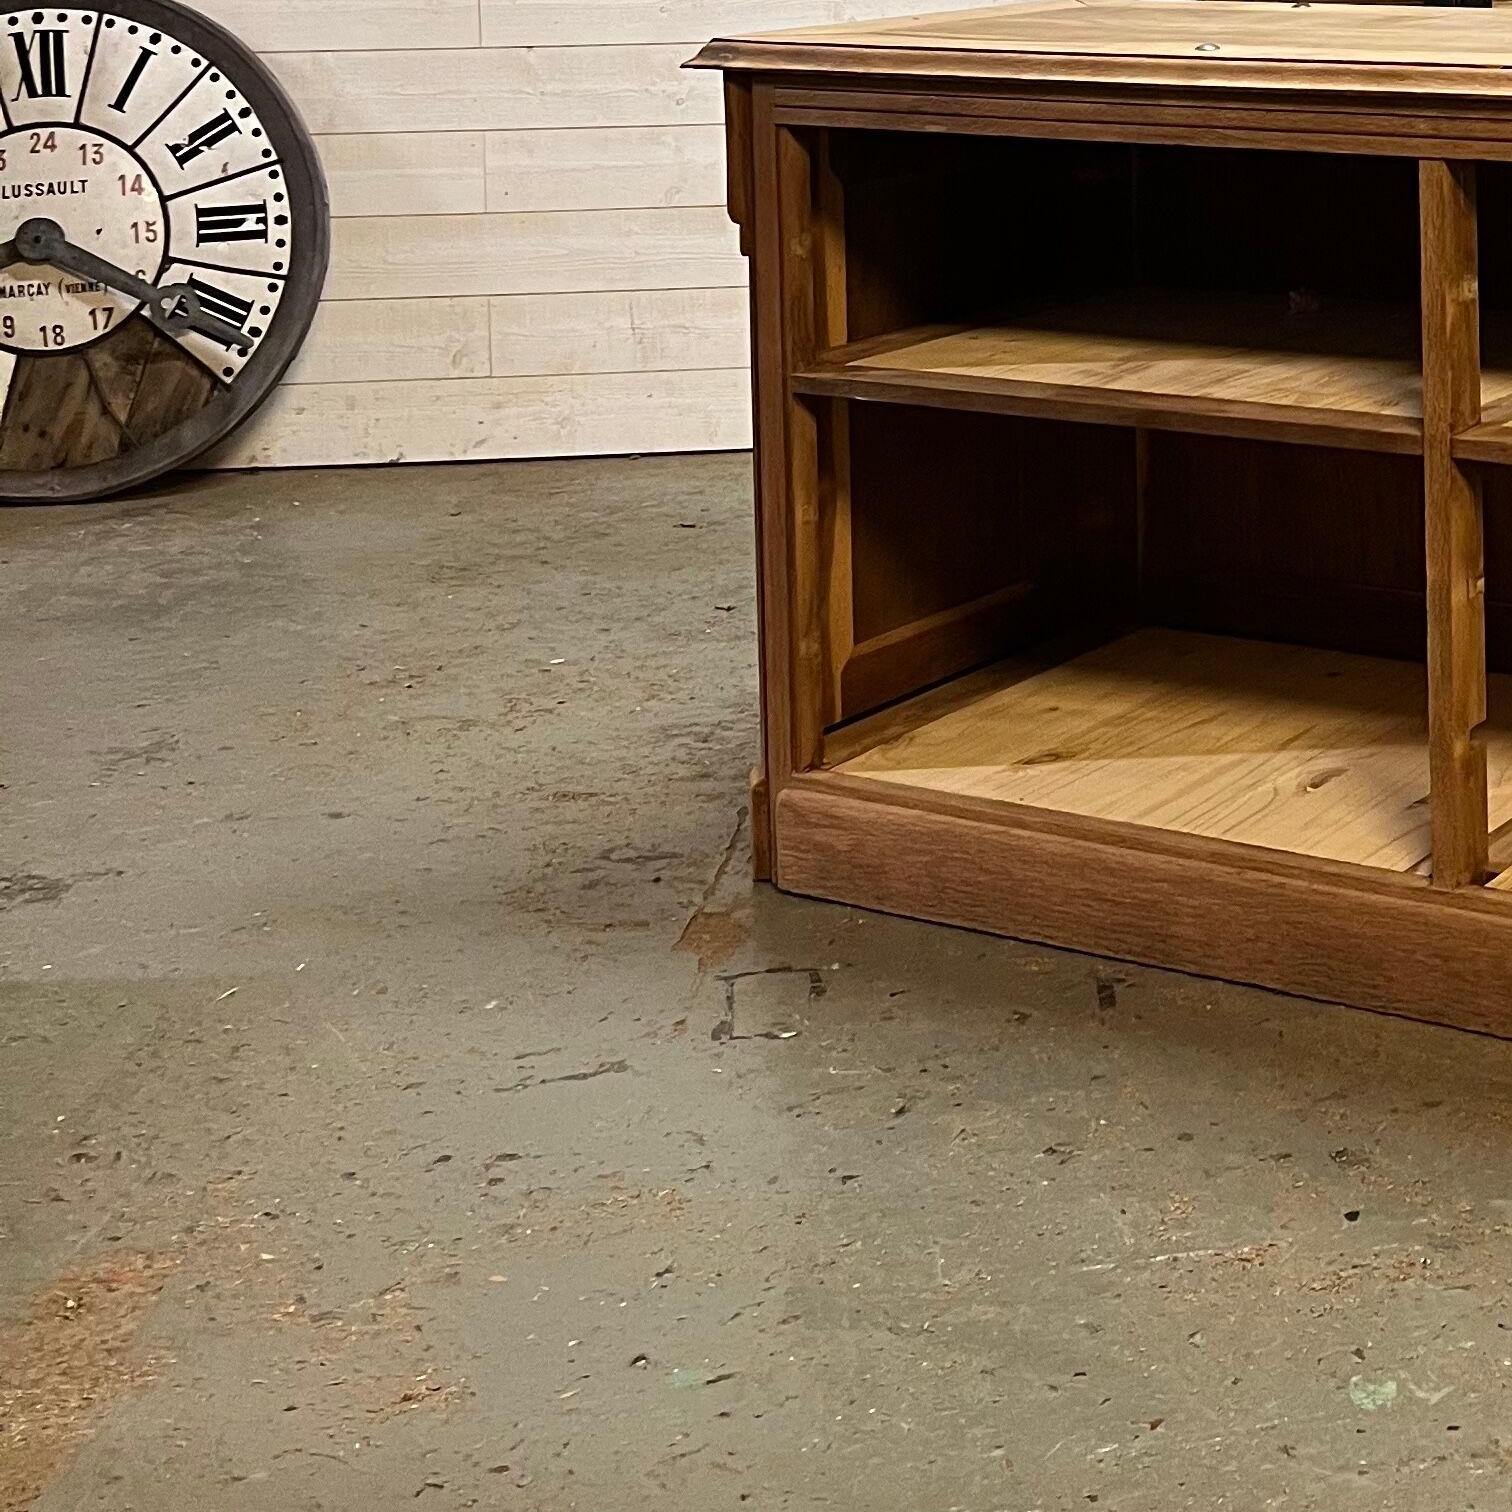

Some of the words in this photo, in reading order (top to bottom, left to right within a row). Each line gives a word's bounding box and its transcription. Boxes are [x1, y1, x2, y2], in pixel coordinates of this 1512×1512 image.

[8, 29, 71, 102] XII
[107, 45, 158, 113] I
[29, 131, 57, 153] 24
[165, 107, 242, 170] II
[78, 143, 104, 165] 13
[1, 179, 88, 200] LUSSAULT
[117, 174, 145, 196] 14
[130, 220, 158, 244] 15
[194, 199, 268, 248] III
[88, 307, 114, 330] 17
[39, 324, 65, 348] 18
